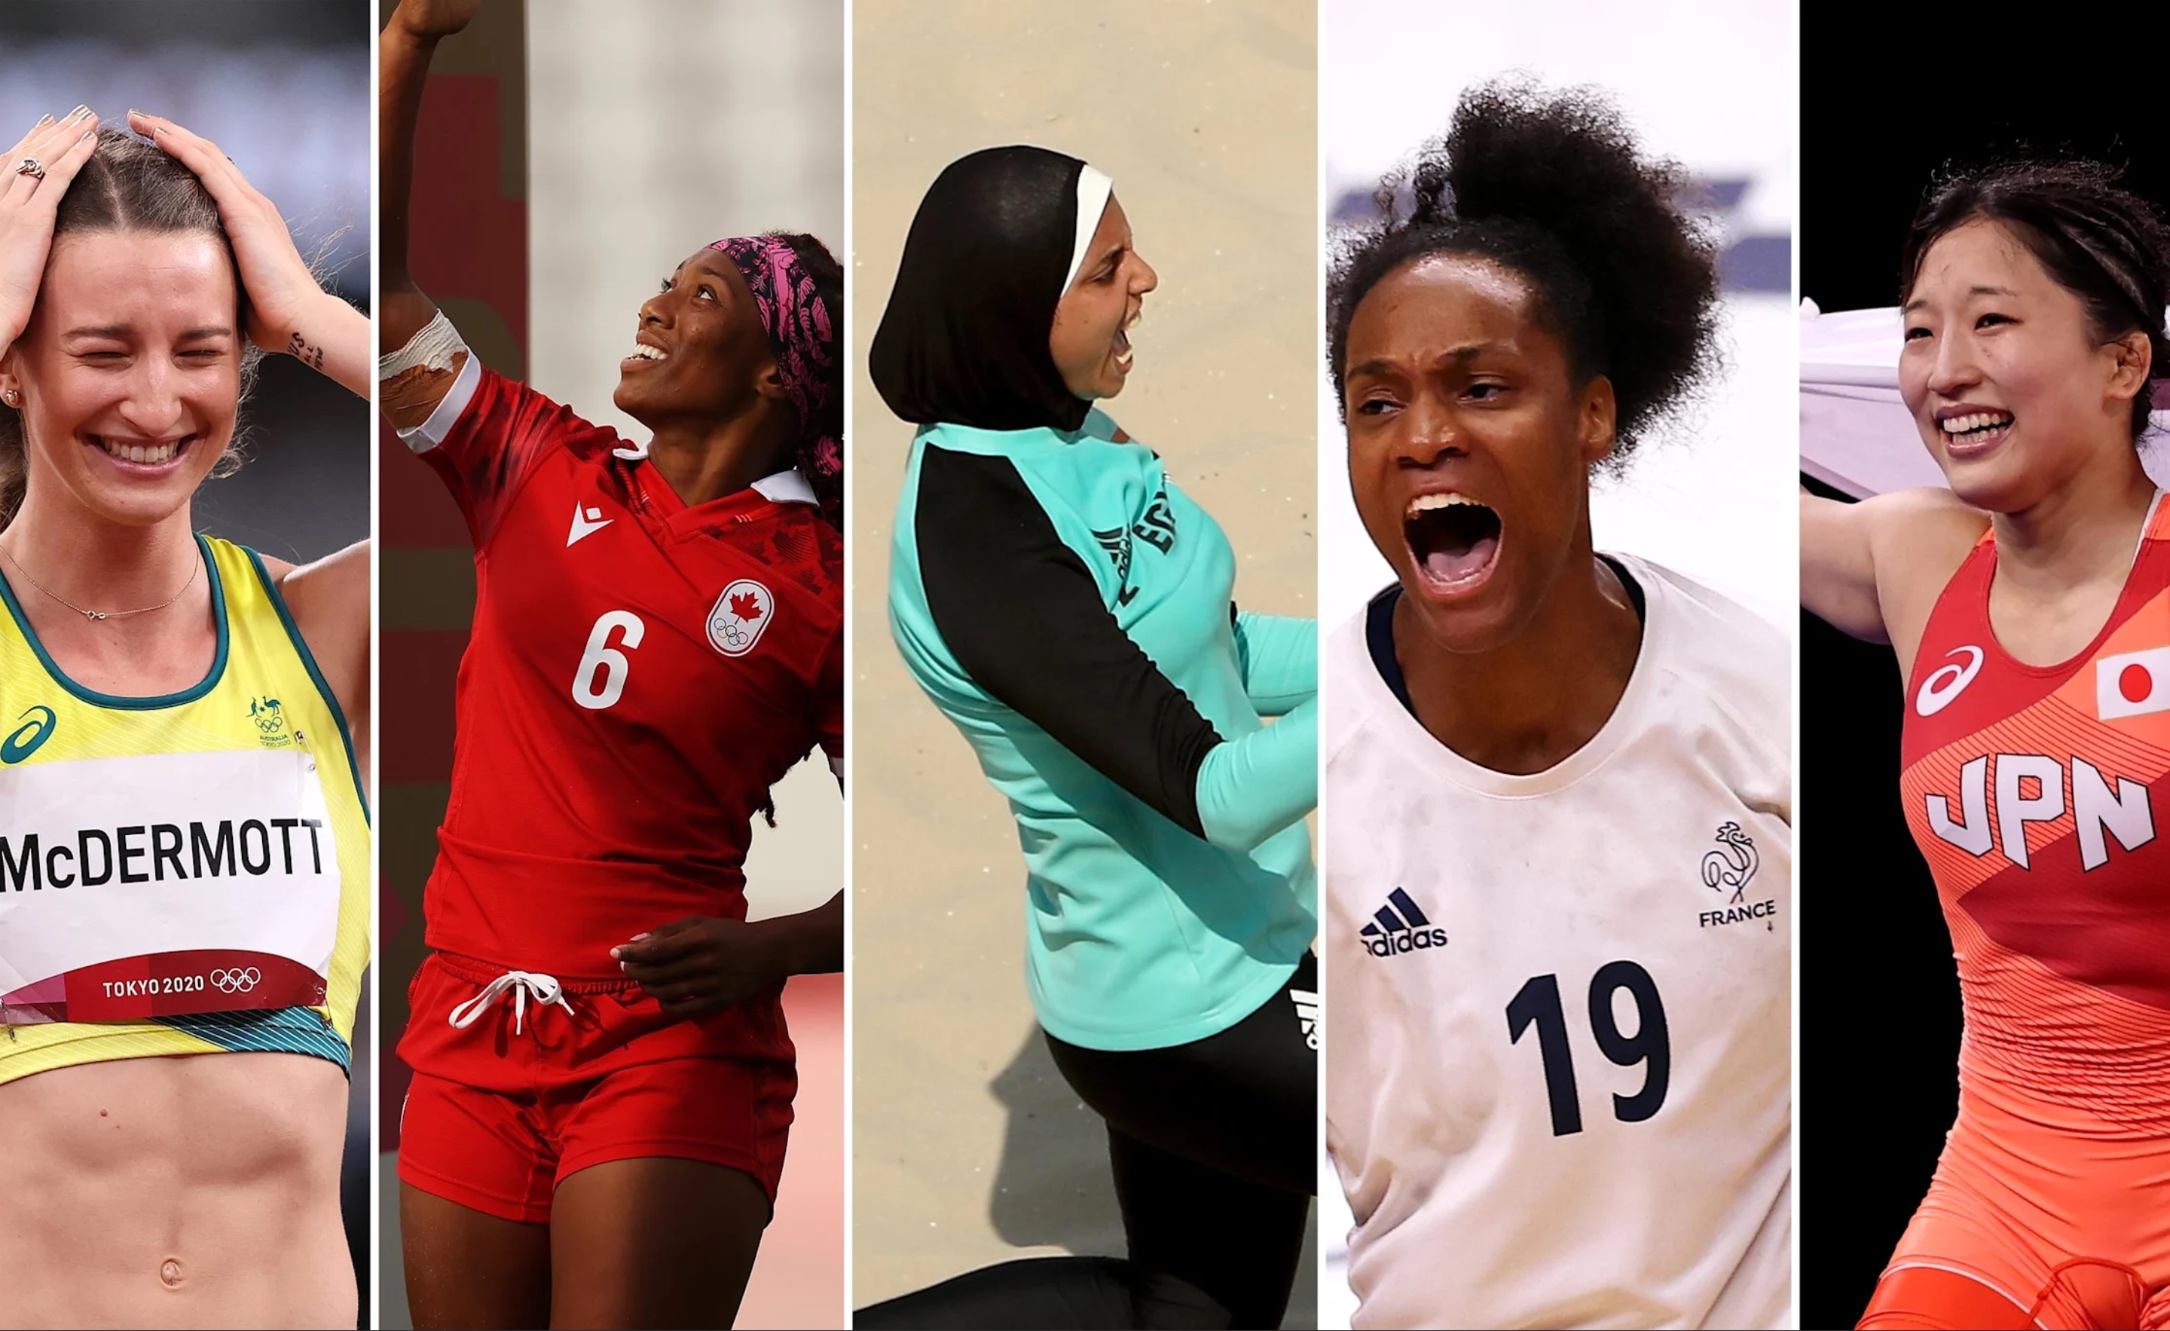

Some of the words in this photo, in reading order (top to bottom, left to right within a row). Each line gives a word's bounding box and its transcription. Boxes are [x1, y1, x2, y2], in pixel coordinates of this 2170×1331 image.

[571, 609, 645, 710] 6
[0, 818, 323, 893] McDERMOTT
[1925, 752, 2157, 873] JPN
[1700, 900, 1777, 928] FRANCE
[102, 979, 160, 998] TOKYO
[163, 975, 205, 993] 2020
[1505, 960, 1671, 1137] 19
